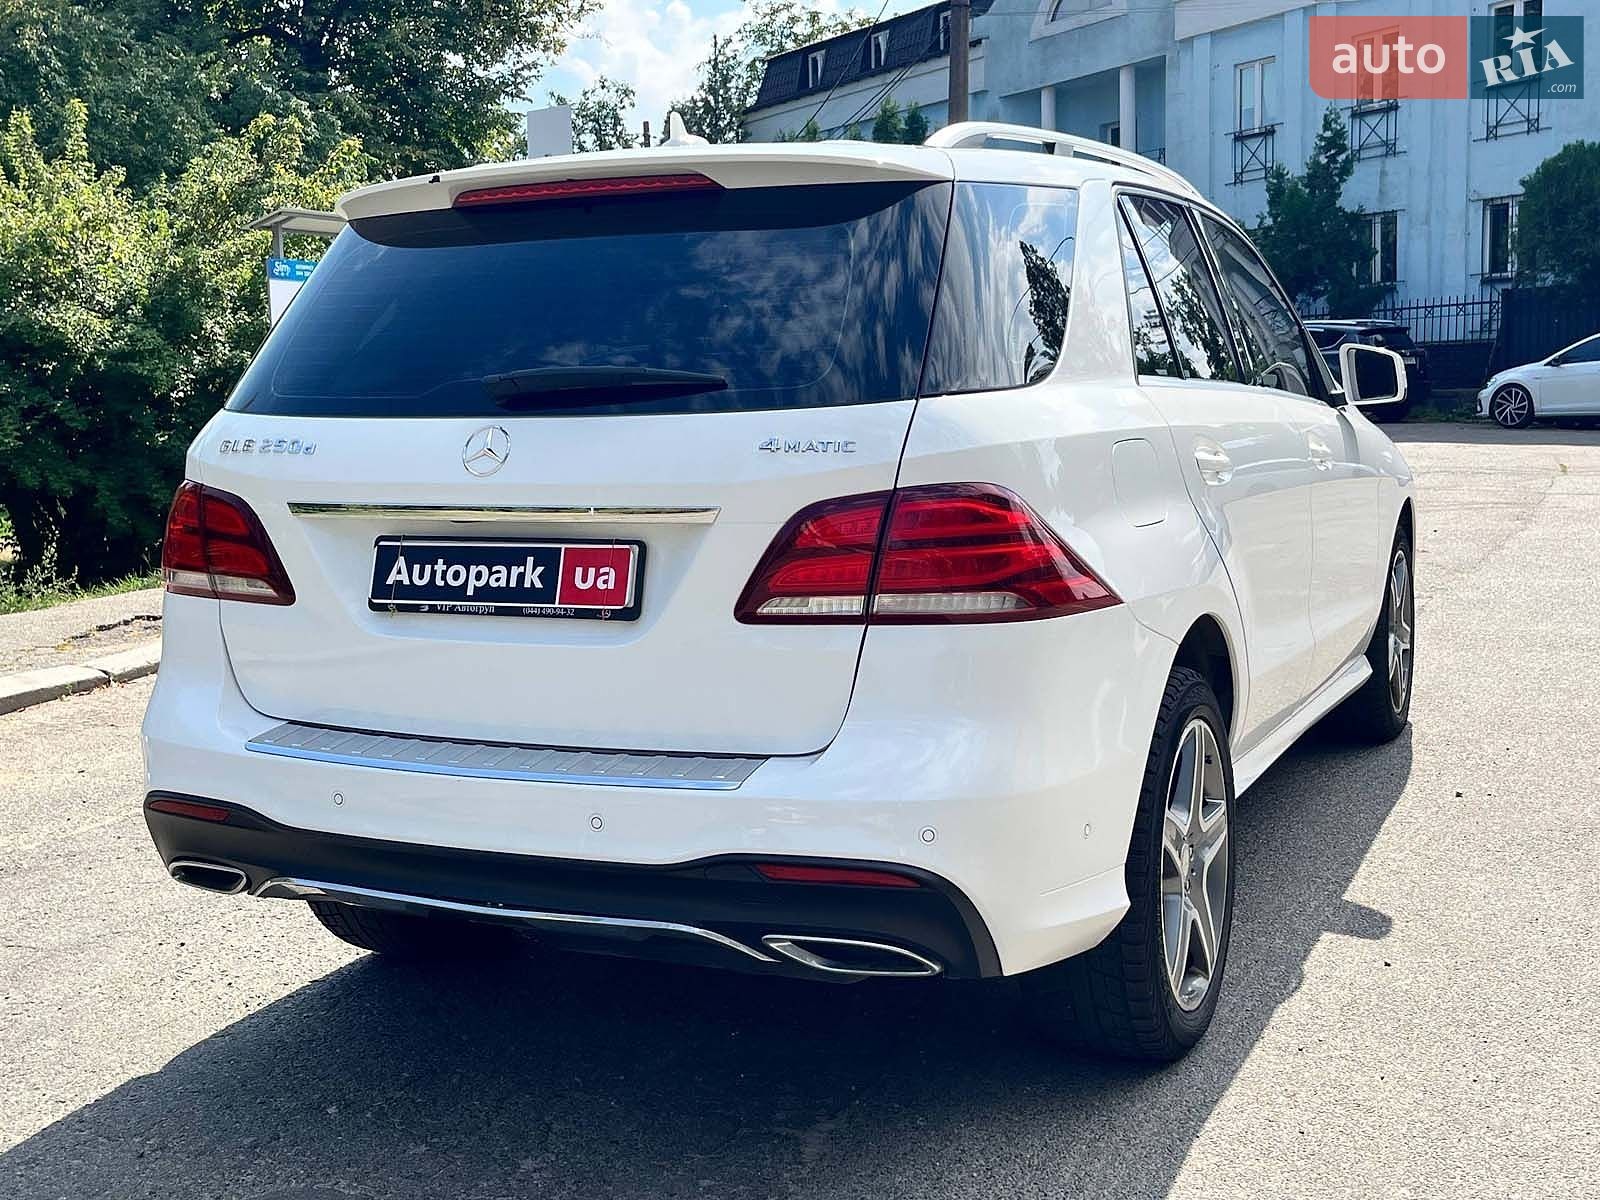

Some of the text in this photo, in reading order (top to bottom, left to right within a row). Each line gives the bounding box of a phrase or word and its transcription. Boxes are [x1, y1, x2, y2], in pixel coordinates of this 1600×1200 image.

[219, 439, 317, 454] GLE 250d
[386, 556, 615, 596] Autopark ua
